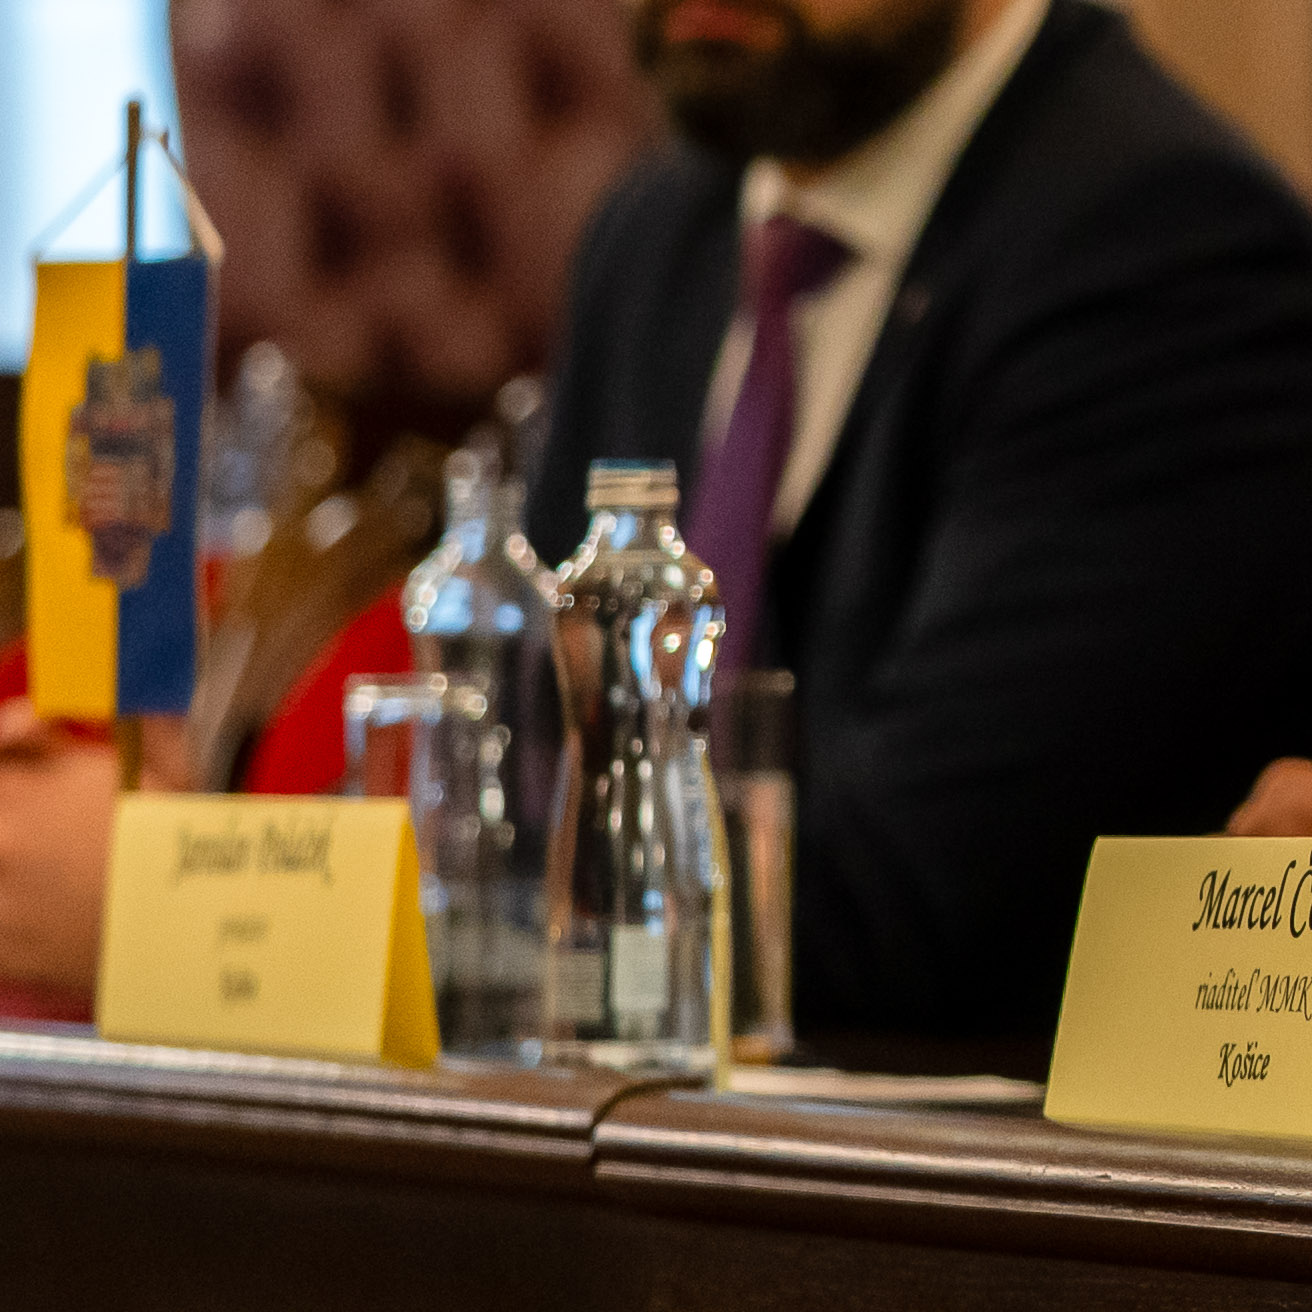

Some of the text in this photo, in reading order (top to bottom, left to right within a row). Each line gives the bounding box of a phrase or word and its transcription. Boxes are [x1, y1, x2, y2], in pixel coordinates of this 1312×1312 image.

[1192, 859, 1297, 932] Marcel
[1195, 967, 1261, 1012] riaditeľ
[1217, 1041, 1271, 1088] Košice
